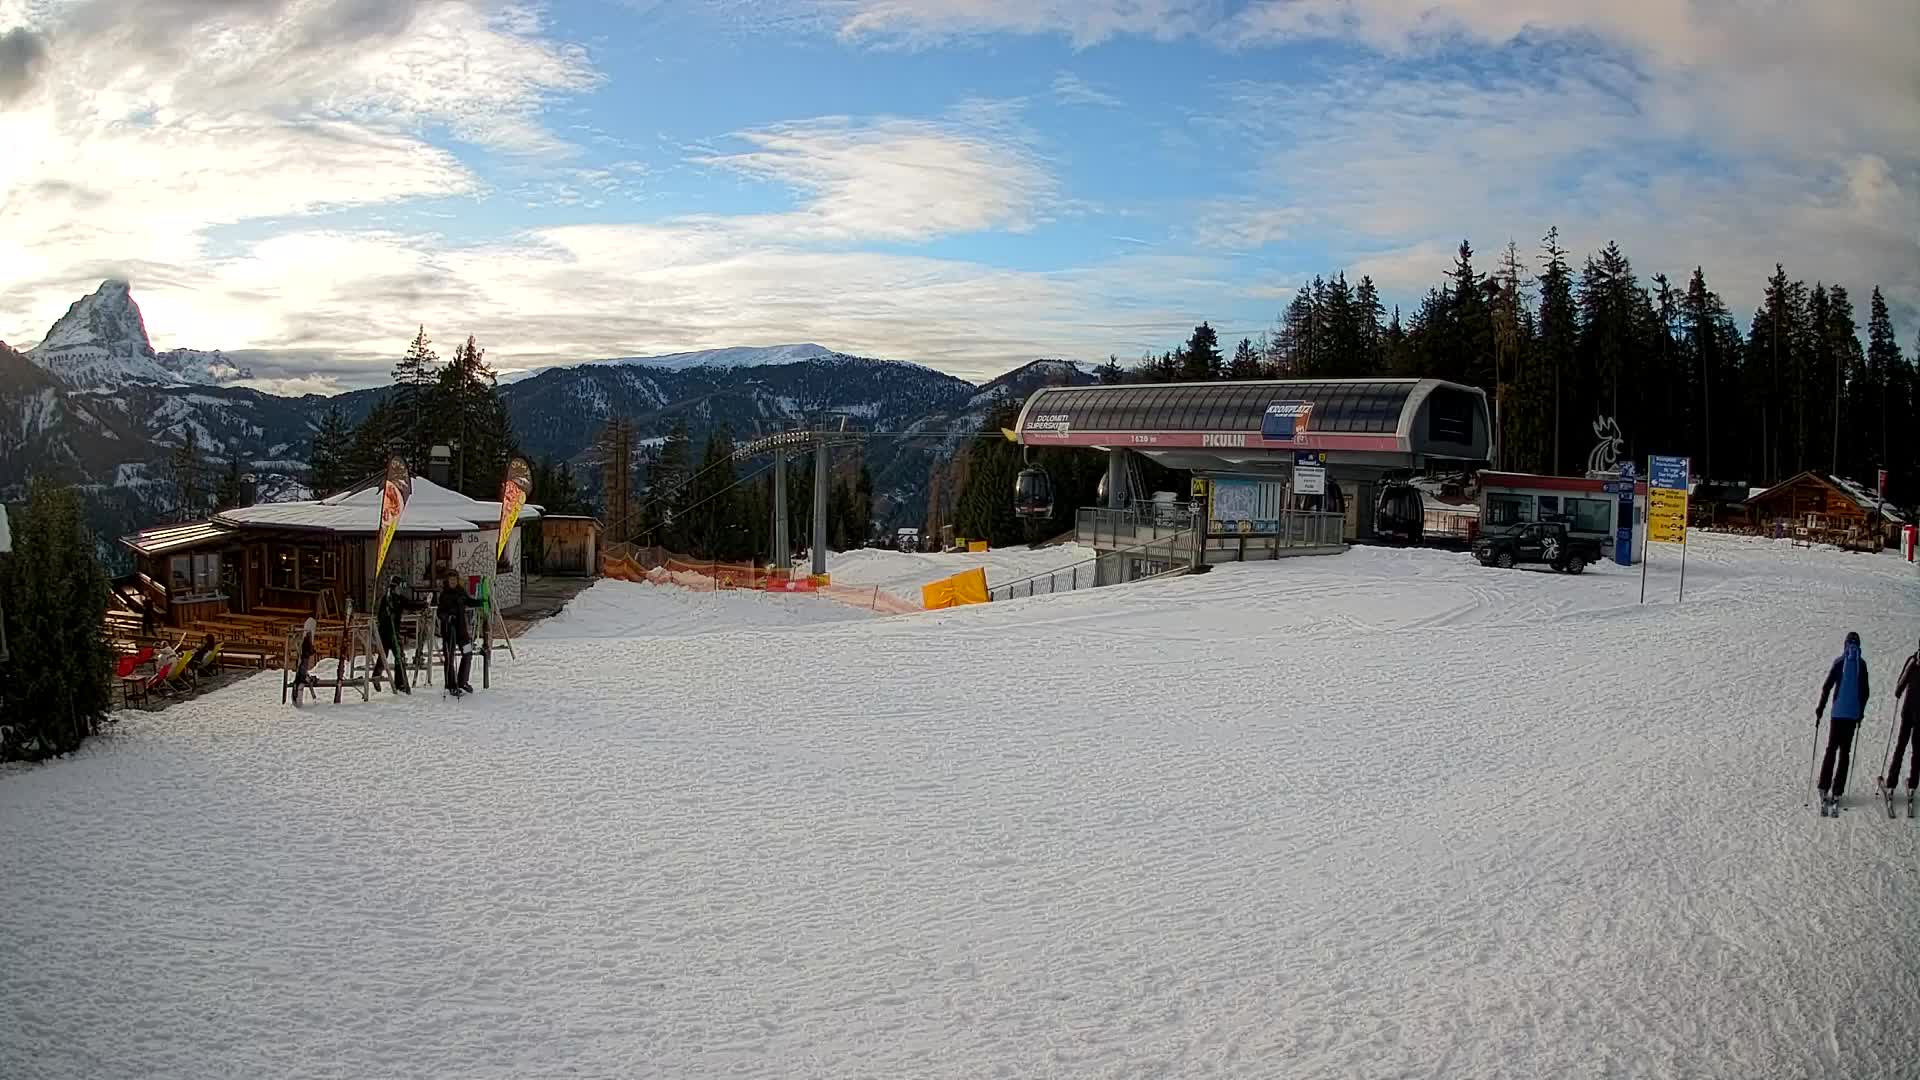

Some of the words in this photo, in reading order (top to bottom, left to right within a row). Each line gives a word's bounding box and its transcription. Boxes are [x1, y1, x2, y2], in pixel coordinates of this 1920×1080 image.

[1266, 405, 1313, 414] KRONPLATZ
[1026, 422, 1059, 430] SUPERSKI
[1202, 434, 1246, 447] PICULIN
